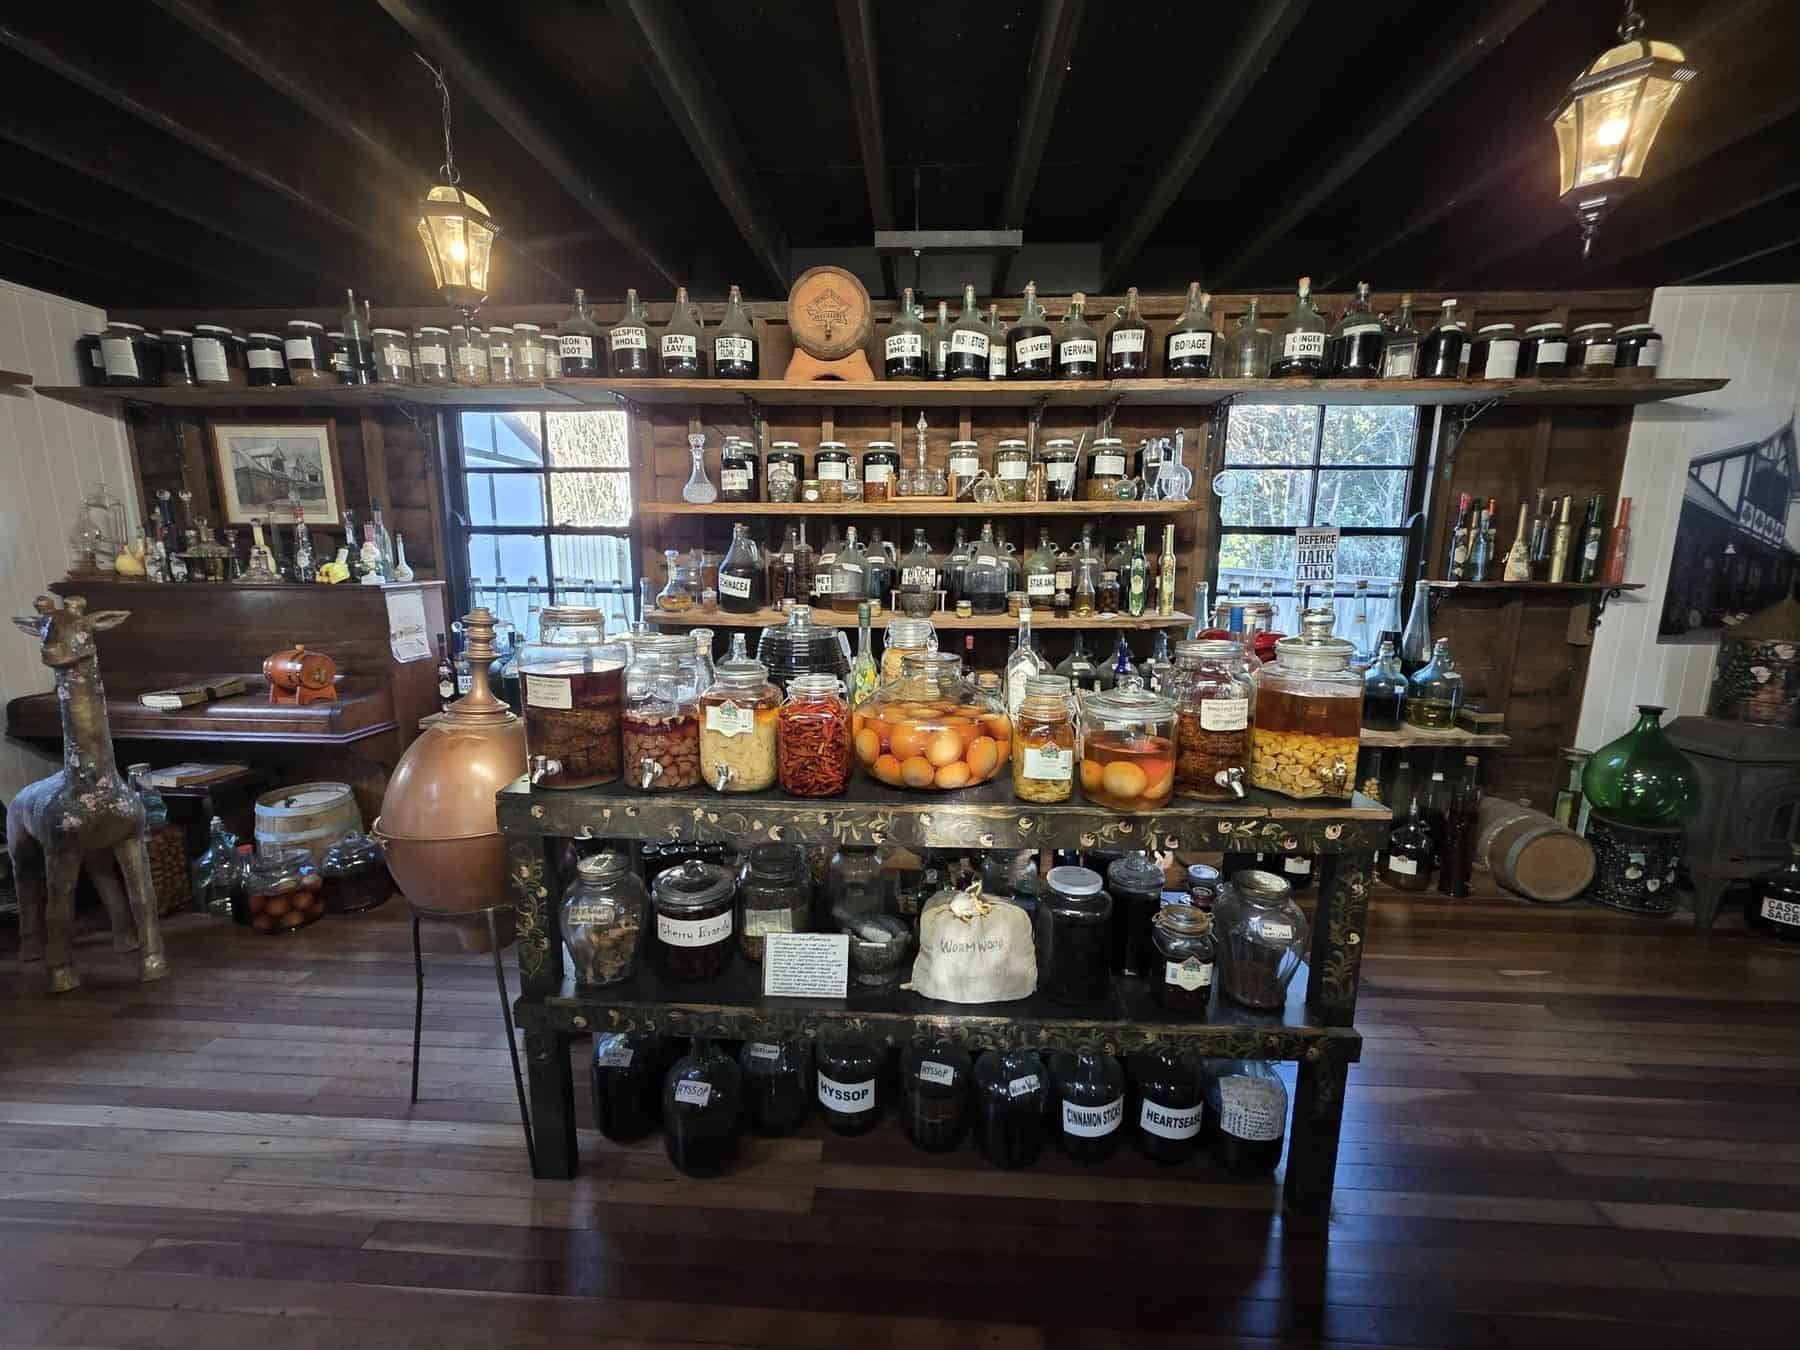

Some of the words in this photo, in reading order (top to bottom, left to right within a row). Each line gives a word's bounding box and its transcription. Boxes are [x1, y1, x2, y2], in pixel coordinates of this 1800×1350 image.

[889, 346, 917, 354] WHOE
[1298, 534, 1337, 545] DEFENCE
[1297, 550, 1335, 564] DARK
[1296, 564, 1334, 581] ARTS
[676, 1082, 710, 1097] HYSSOP
[820, 1080, 869, 1101] HYSSOP
[1066, 1107, 1102, 1128] CINNAMON
